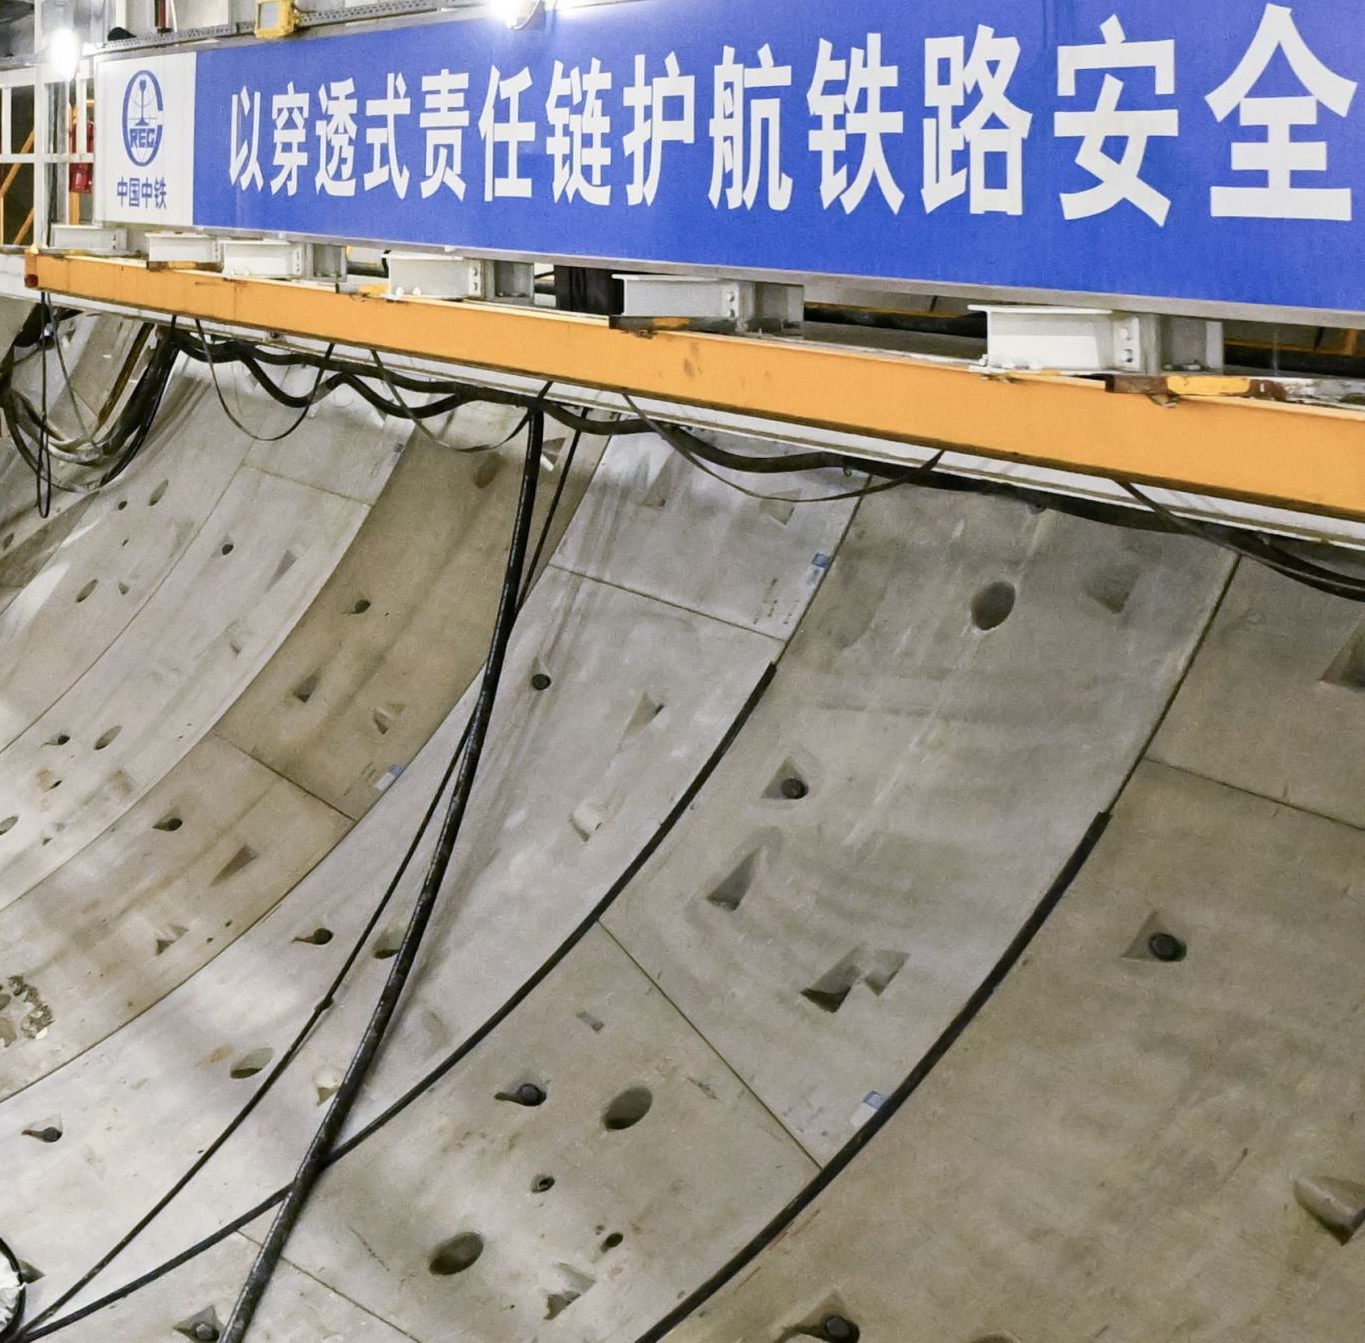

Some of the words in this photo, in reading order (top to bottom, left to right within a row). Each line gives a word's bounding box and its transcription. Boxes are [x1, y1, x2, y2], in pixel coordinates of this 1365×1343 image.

[229, 3, 1358, 228] 以穿透式责任链护航铁路安全
[116, 176, 167, 209] 中国中铁
